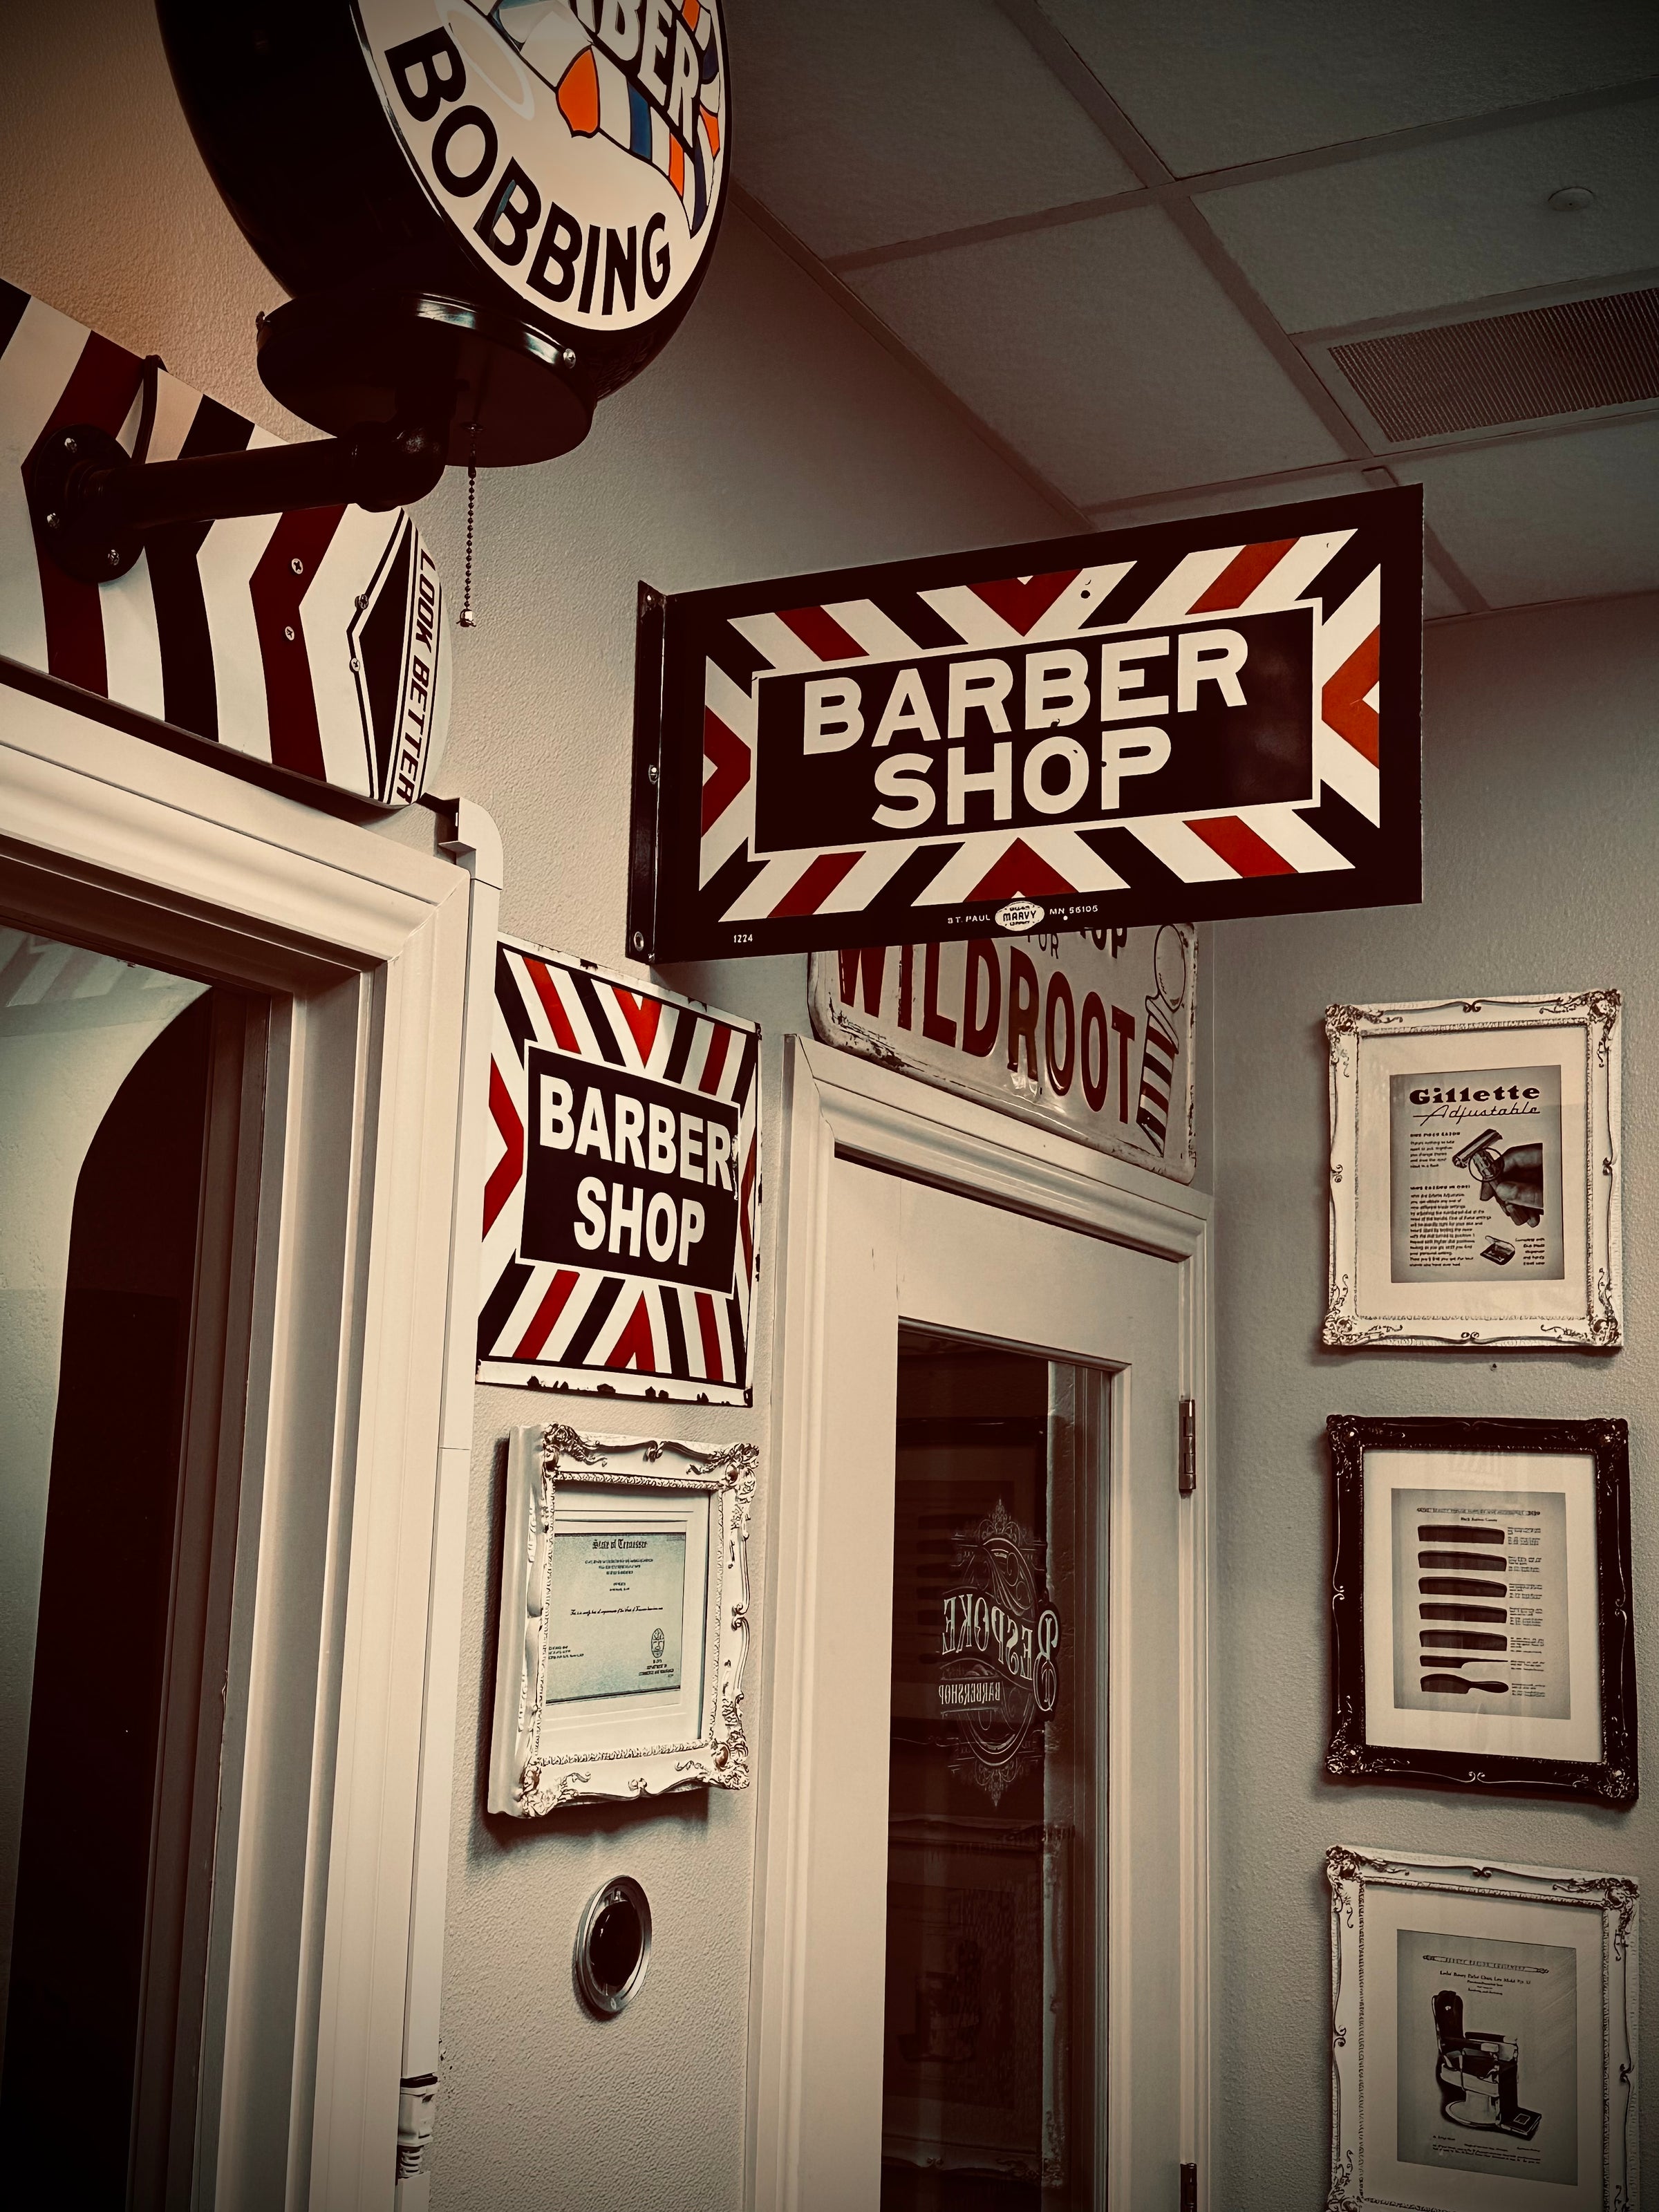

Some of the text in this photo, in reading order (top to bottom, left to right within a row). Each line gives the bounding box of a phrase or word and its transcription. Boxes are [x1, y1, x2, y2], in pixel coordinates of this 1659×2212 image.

[577, 0, 700, 148] BER
[384, 26, 671, 315] BOBBING
[396, 548, 436, 804] LOOK BETTER
[803, 628, 1248, 756] BARBER
[872, 726, 1172, 830] SHOP
[733, 934, 753, 943] 1224
[966, 914, 991, 922] PAUL
[1003, 910, 1036, 921] MARVY
[539, 1074, 733, 1191] BARBER
[1409, 1085, 1540, 1105] Gillette
[1412, 1101, 1541, 1127] Adjustable
[573, 1177, 706, 1266] SHOP
